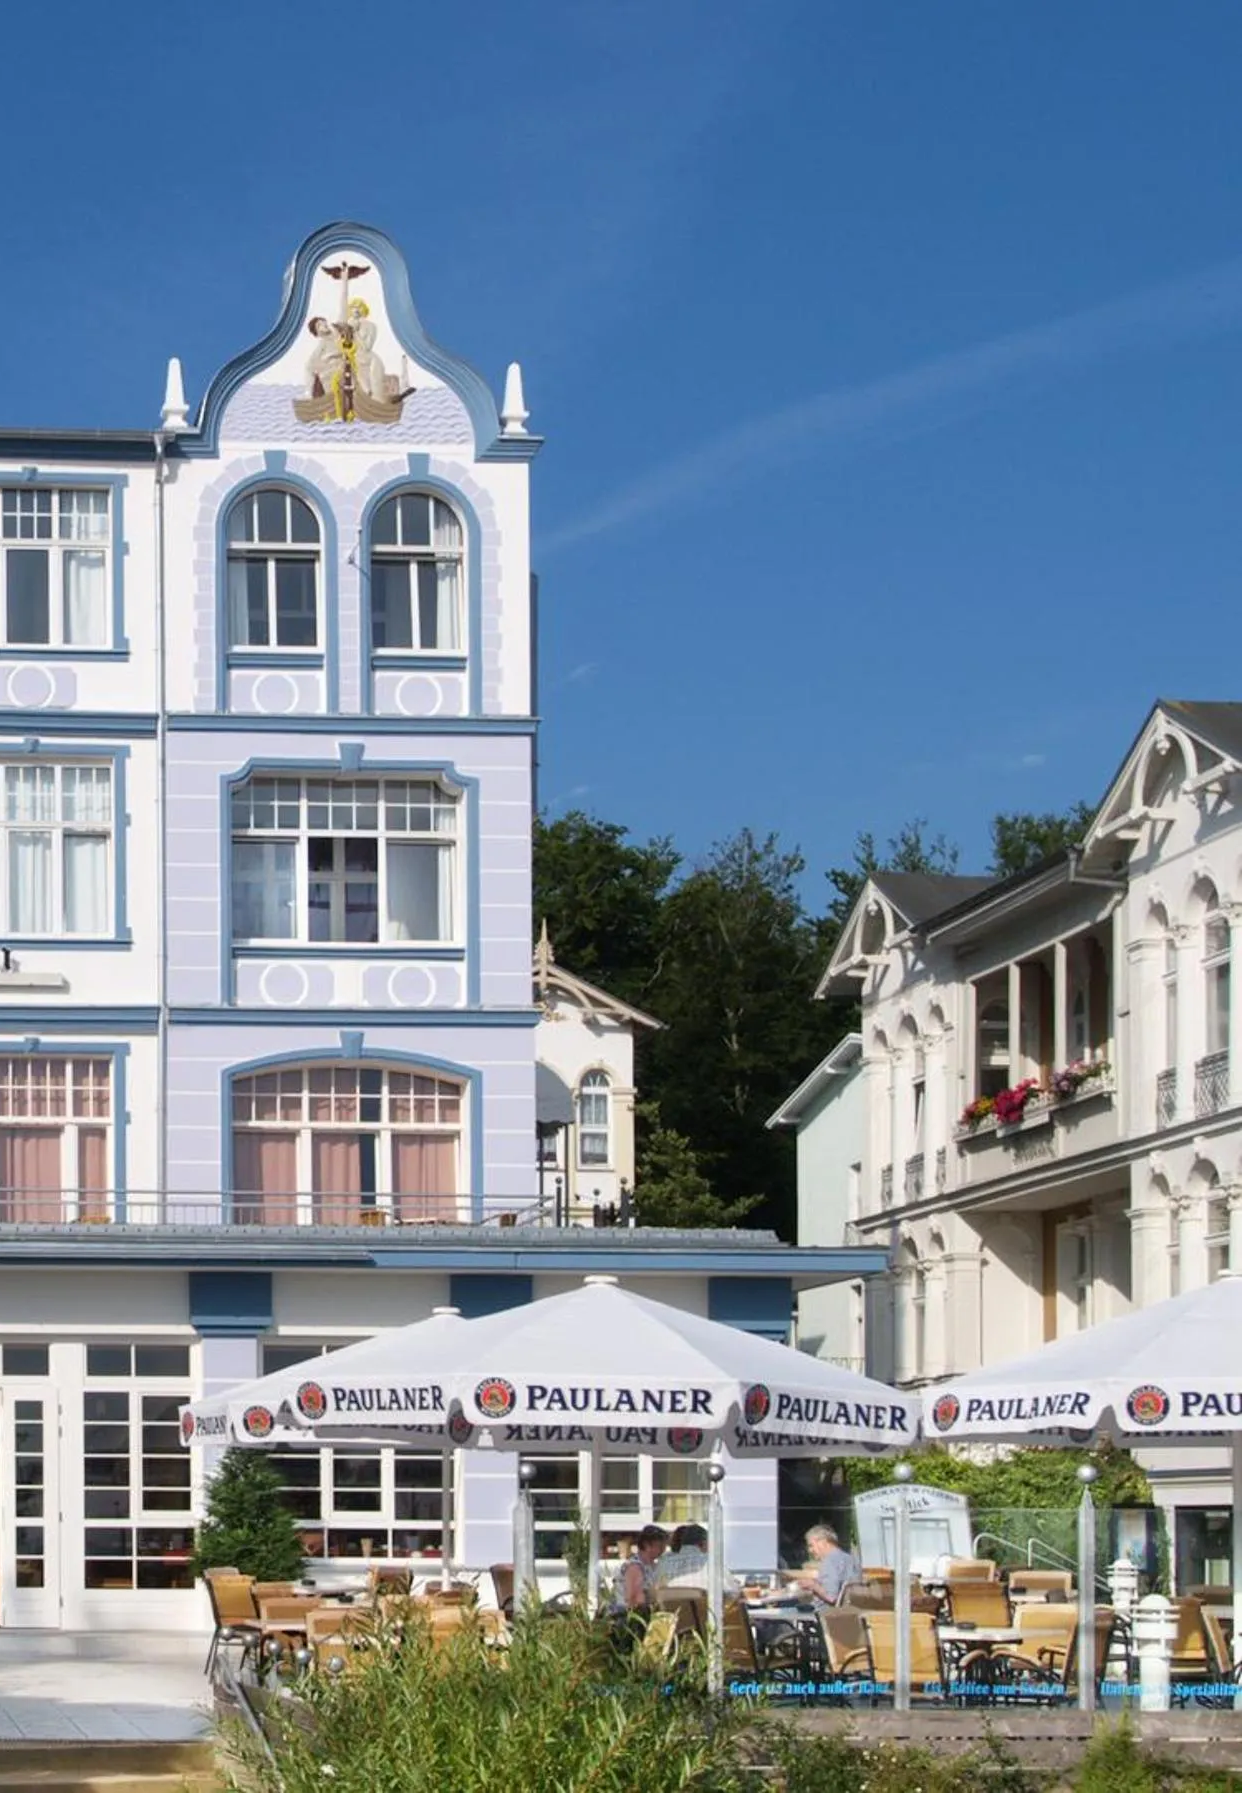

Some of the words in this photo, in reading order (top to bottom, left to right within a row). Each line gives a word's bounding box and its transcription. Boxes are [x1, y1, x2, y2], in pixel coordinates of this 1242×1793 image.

[332, 1385, 445, 1412] PAULANER
[526, 1385, 714, 1416] PAULANER
[776, 1393, 909, 1432] PAULANER
[966, 1391, 1091, 1422] PAULANER
[1179, 1391, 1242, 1417] PAU
